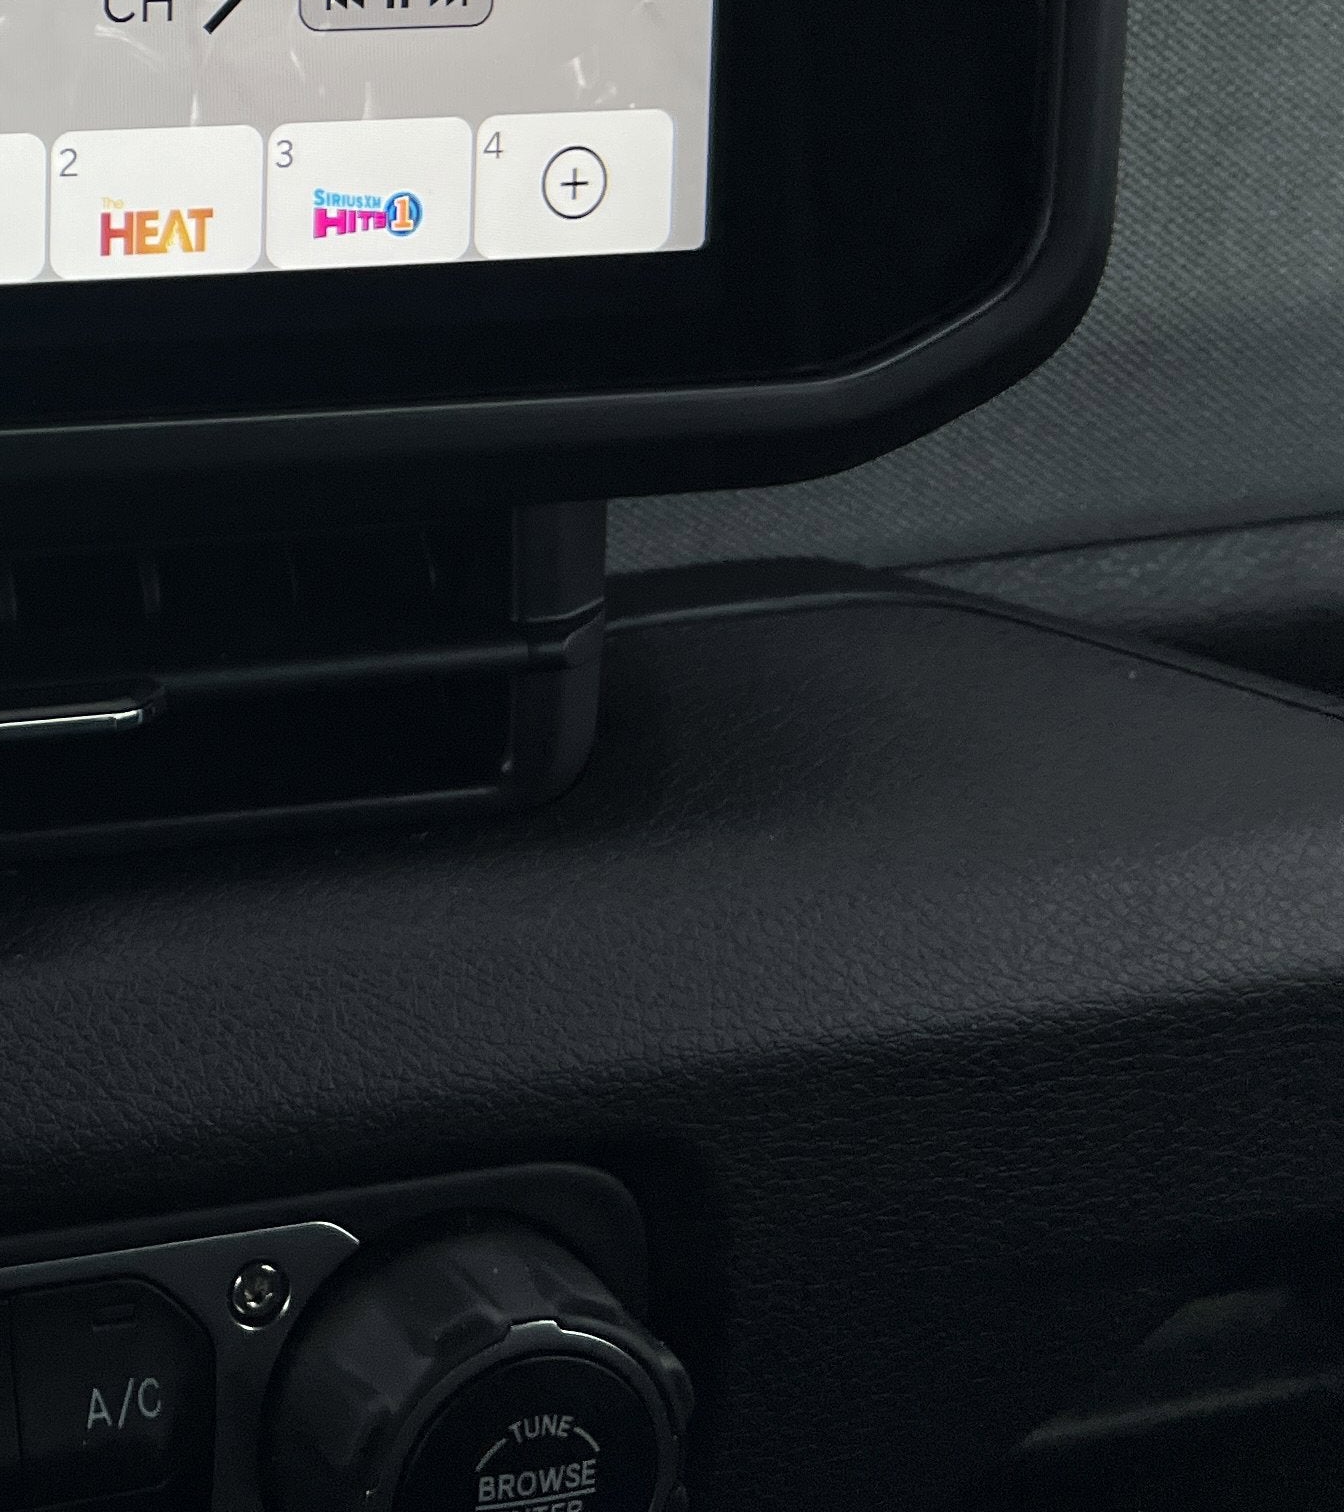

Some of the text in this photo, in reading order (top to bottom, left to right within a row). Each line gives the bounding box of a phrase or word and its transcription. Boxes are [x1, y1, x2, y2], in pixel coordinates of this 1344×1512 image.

[275, 139, 294, 168] 3
[482, 131, 504, 159] 4
[58, 148, 78, 177] 2
[101, 196, 125, 210] The
[100, 208, 214, 257] HEAT
[313, 207, 388, 239] HITS
[86, 1377, 162, 1429] A/C
[509, 1414, 574, 1443] TUNE
[477, 1458, 597, 1503] BROWSE
